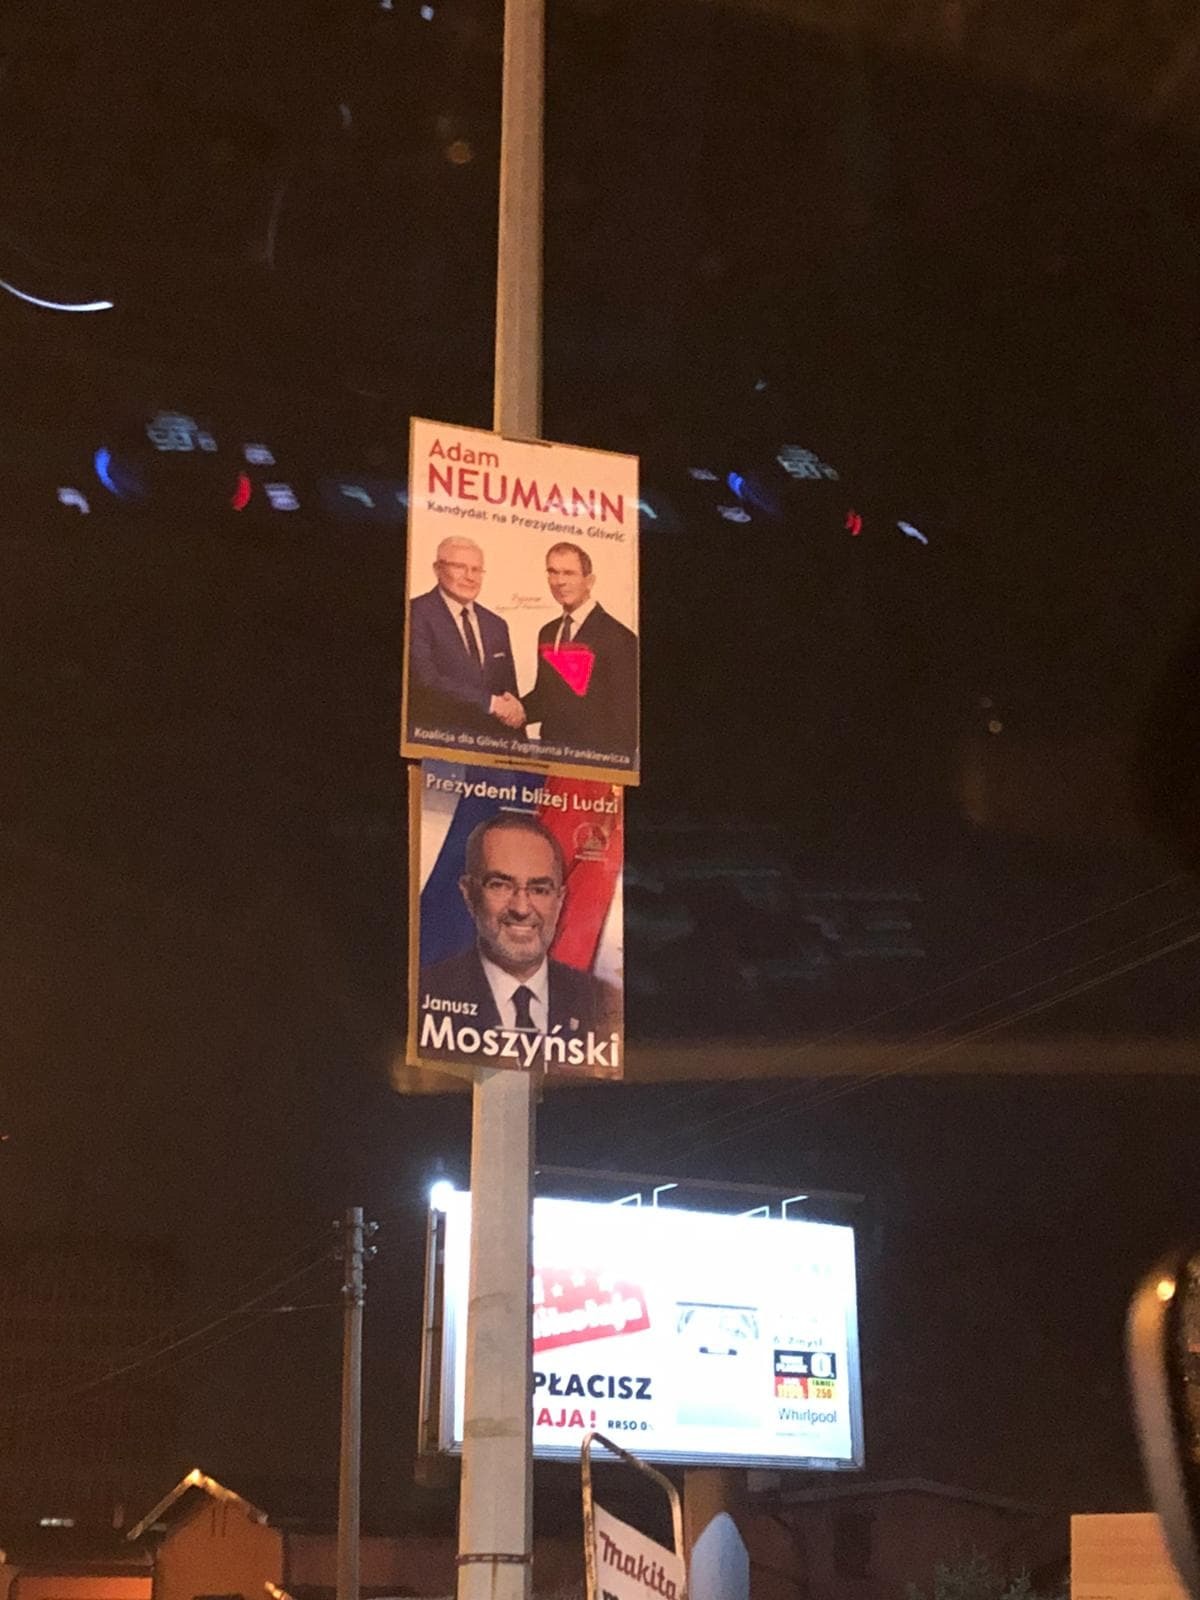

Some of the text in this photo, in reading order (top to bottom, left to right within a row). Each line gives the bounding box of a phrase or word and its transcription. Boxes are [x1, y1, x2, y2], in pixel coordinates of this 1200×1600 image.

[428, 438, 499, 468] Adam
[428, 463, 625, 524] NEUMANN
[427, 500, 626, 542] Kandydat na Prezydenta Gliwic
[413, 727, 630, 764] Koalicja dla Gliwic Zygmunta Frankiewicza
[426, 772, 619, 815] Prezydent bliżej Ludzi
[421, 993, 479, 1016] Janusz
[419, 1013, 620, 1067] Moszyński
[533, 1371, 652, 1400] PŁACISZ
[534, 1407, 596, 1428] AJA!
[607, 1419, 637, 1430] RRSO
[777, 1407, 838, 1426] Whirlpool
